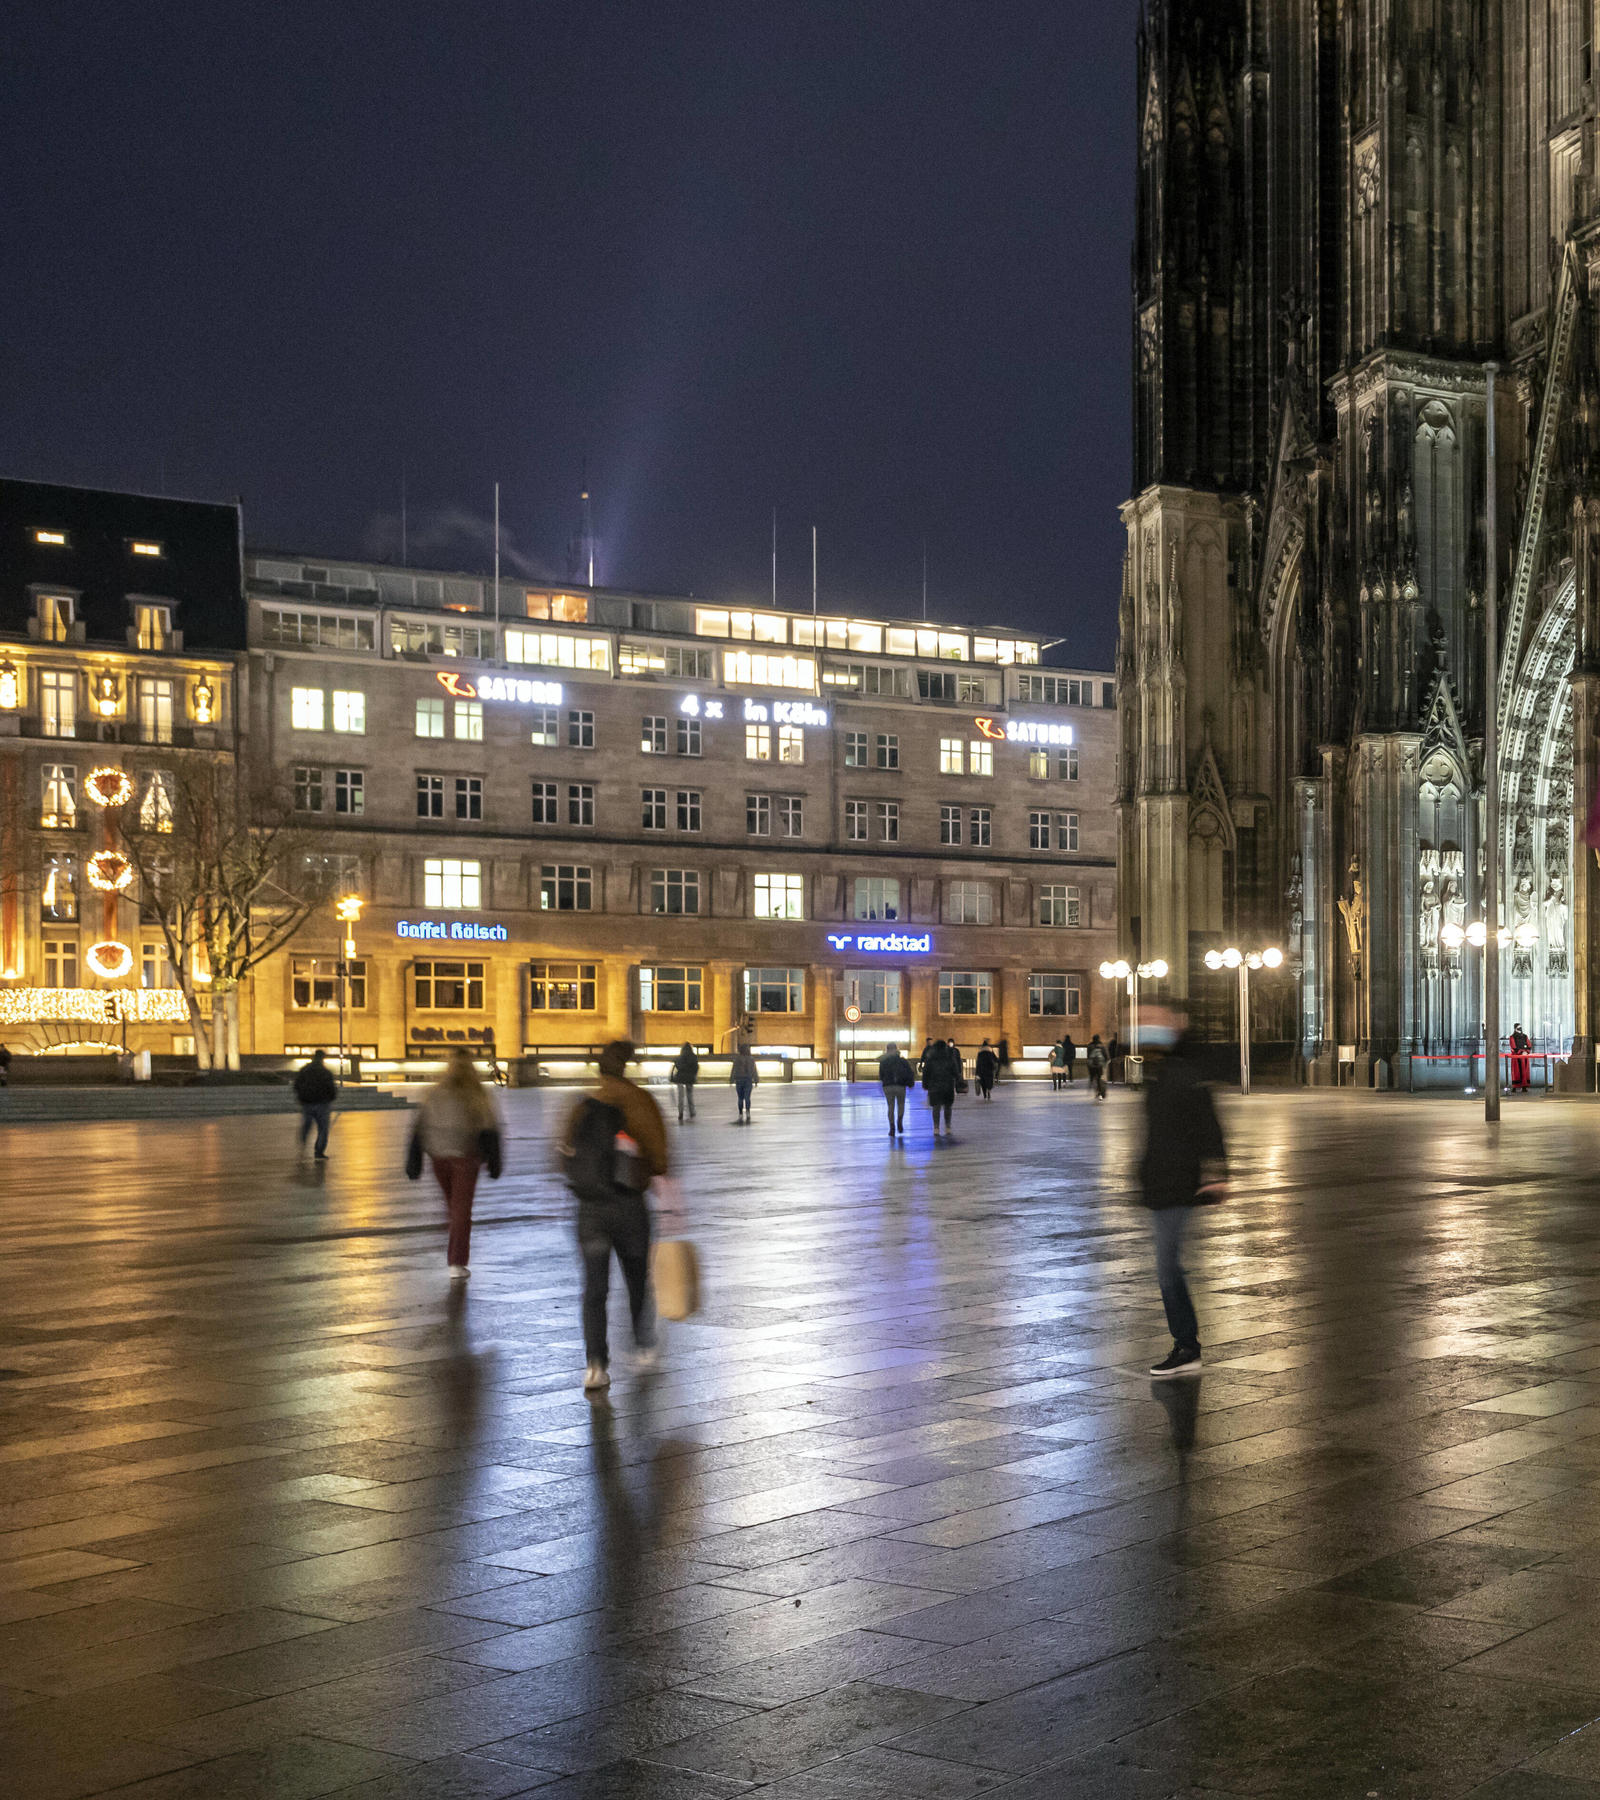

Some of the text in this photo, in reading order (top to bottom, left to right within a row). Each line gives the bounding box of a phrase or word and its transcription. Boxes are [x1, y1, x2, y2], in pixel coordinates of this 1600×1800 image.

[478, 675, 562, 706] SATURN
[680, 694, 700, 717] 4
[744, 698, 768, 722] in
[773, 701, 828, 727] Köln
[1006, 720, 1073, 746] SATURN
[397, 920, 508, 941] Gaffel Kölsch
[857, 932, 930, 953] randstad
